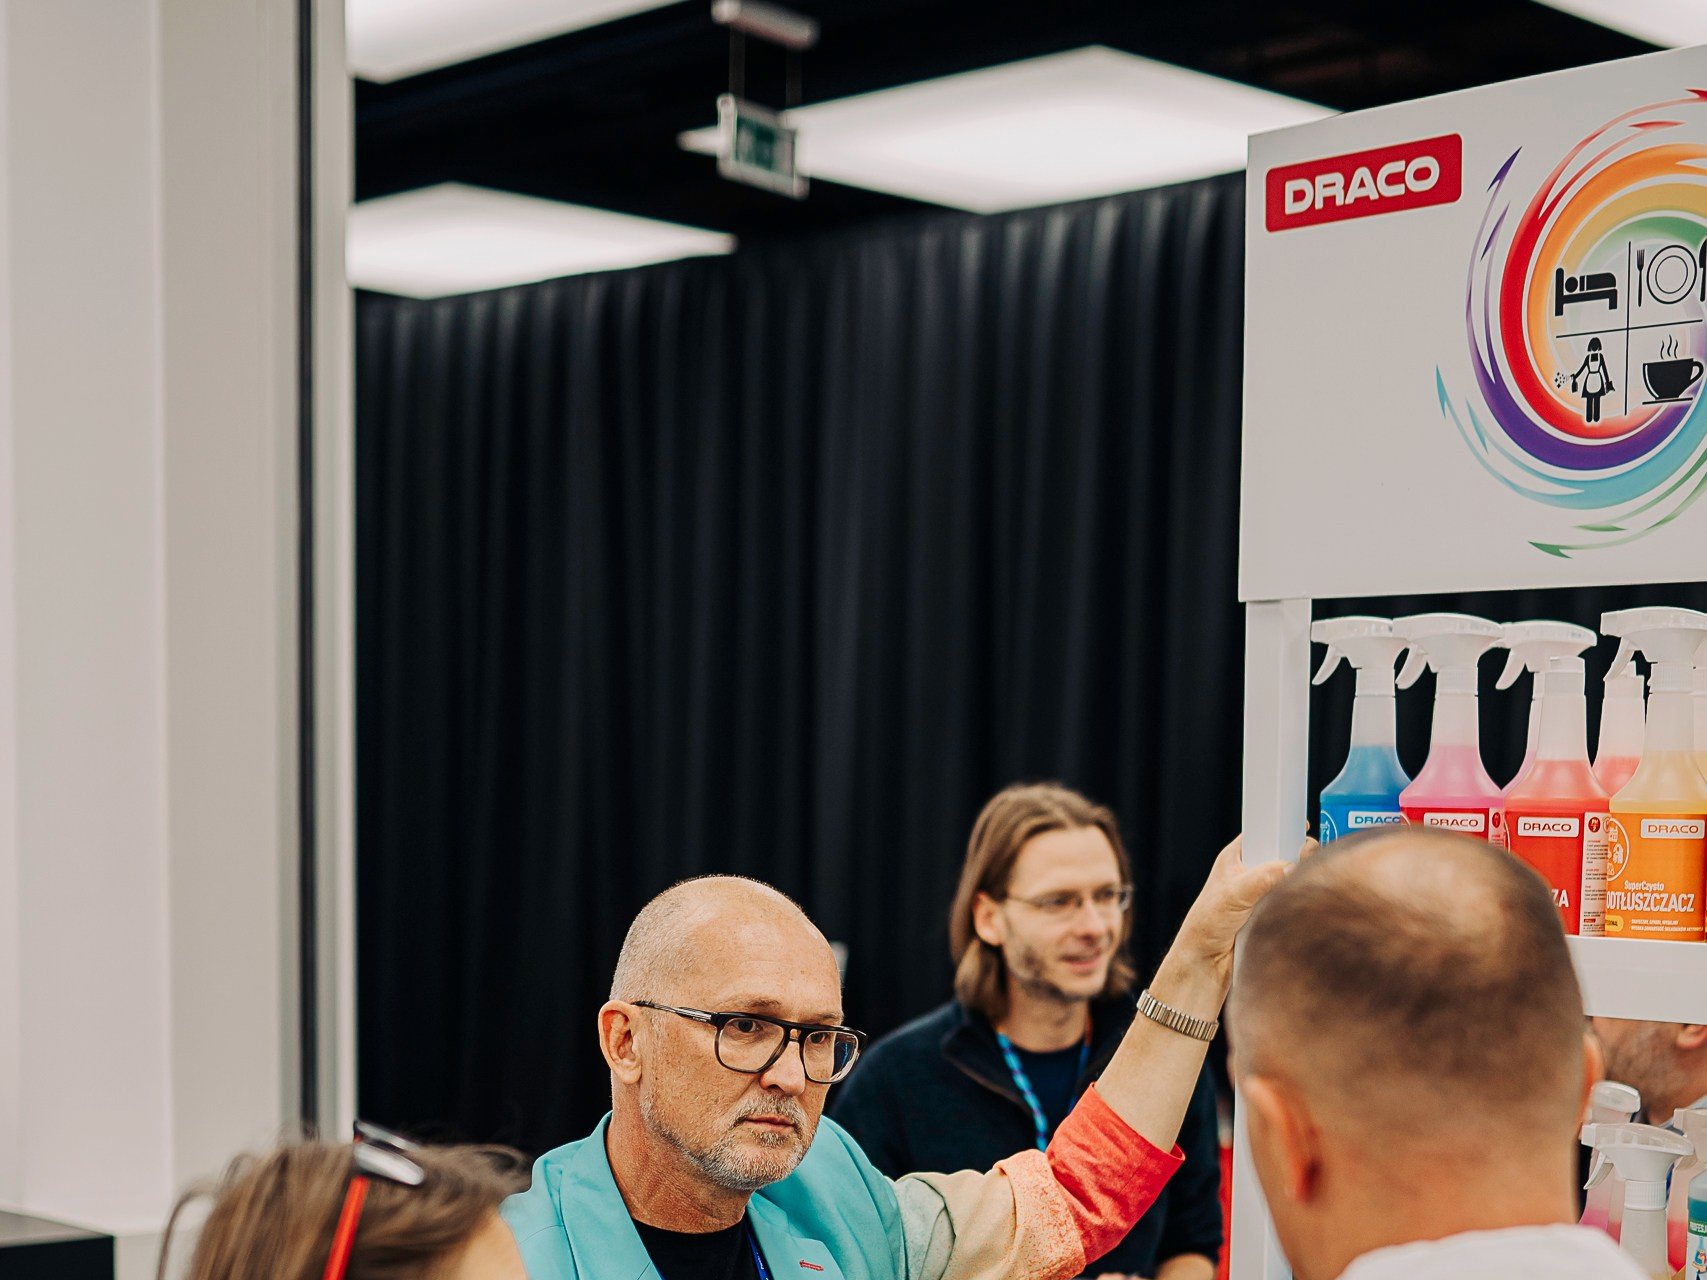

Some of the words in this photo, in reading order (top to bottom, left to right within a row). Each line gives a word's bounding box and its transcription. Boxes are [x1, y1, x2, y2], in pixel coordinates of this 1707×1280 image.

[1284, 155, 1440, 216] DRACO
[1430, 818, 1479, 827] DRACO
[1523, 822, 1572, 832] DRACO
[1647, 824, 1699, 834] DRACO
[1624, 880, 1665, 892] SuperCzysto
[1607, 891, 1695, 912] ODTŁUSZCZACZ
